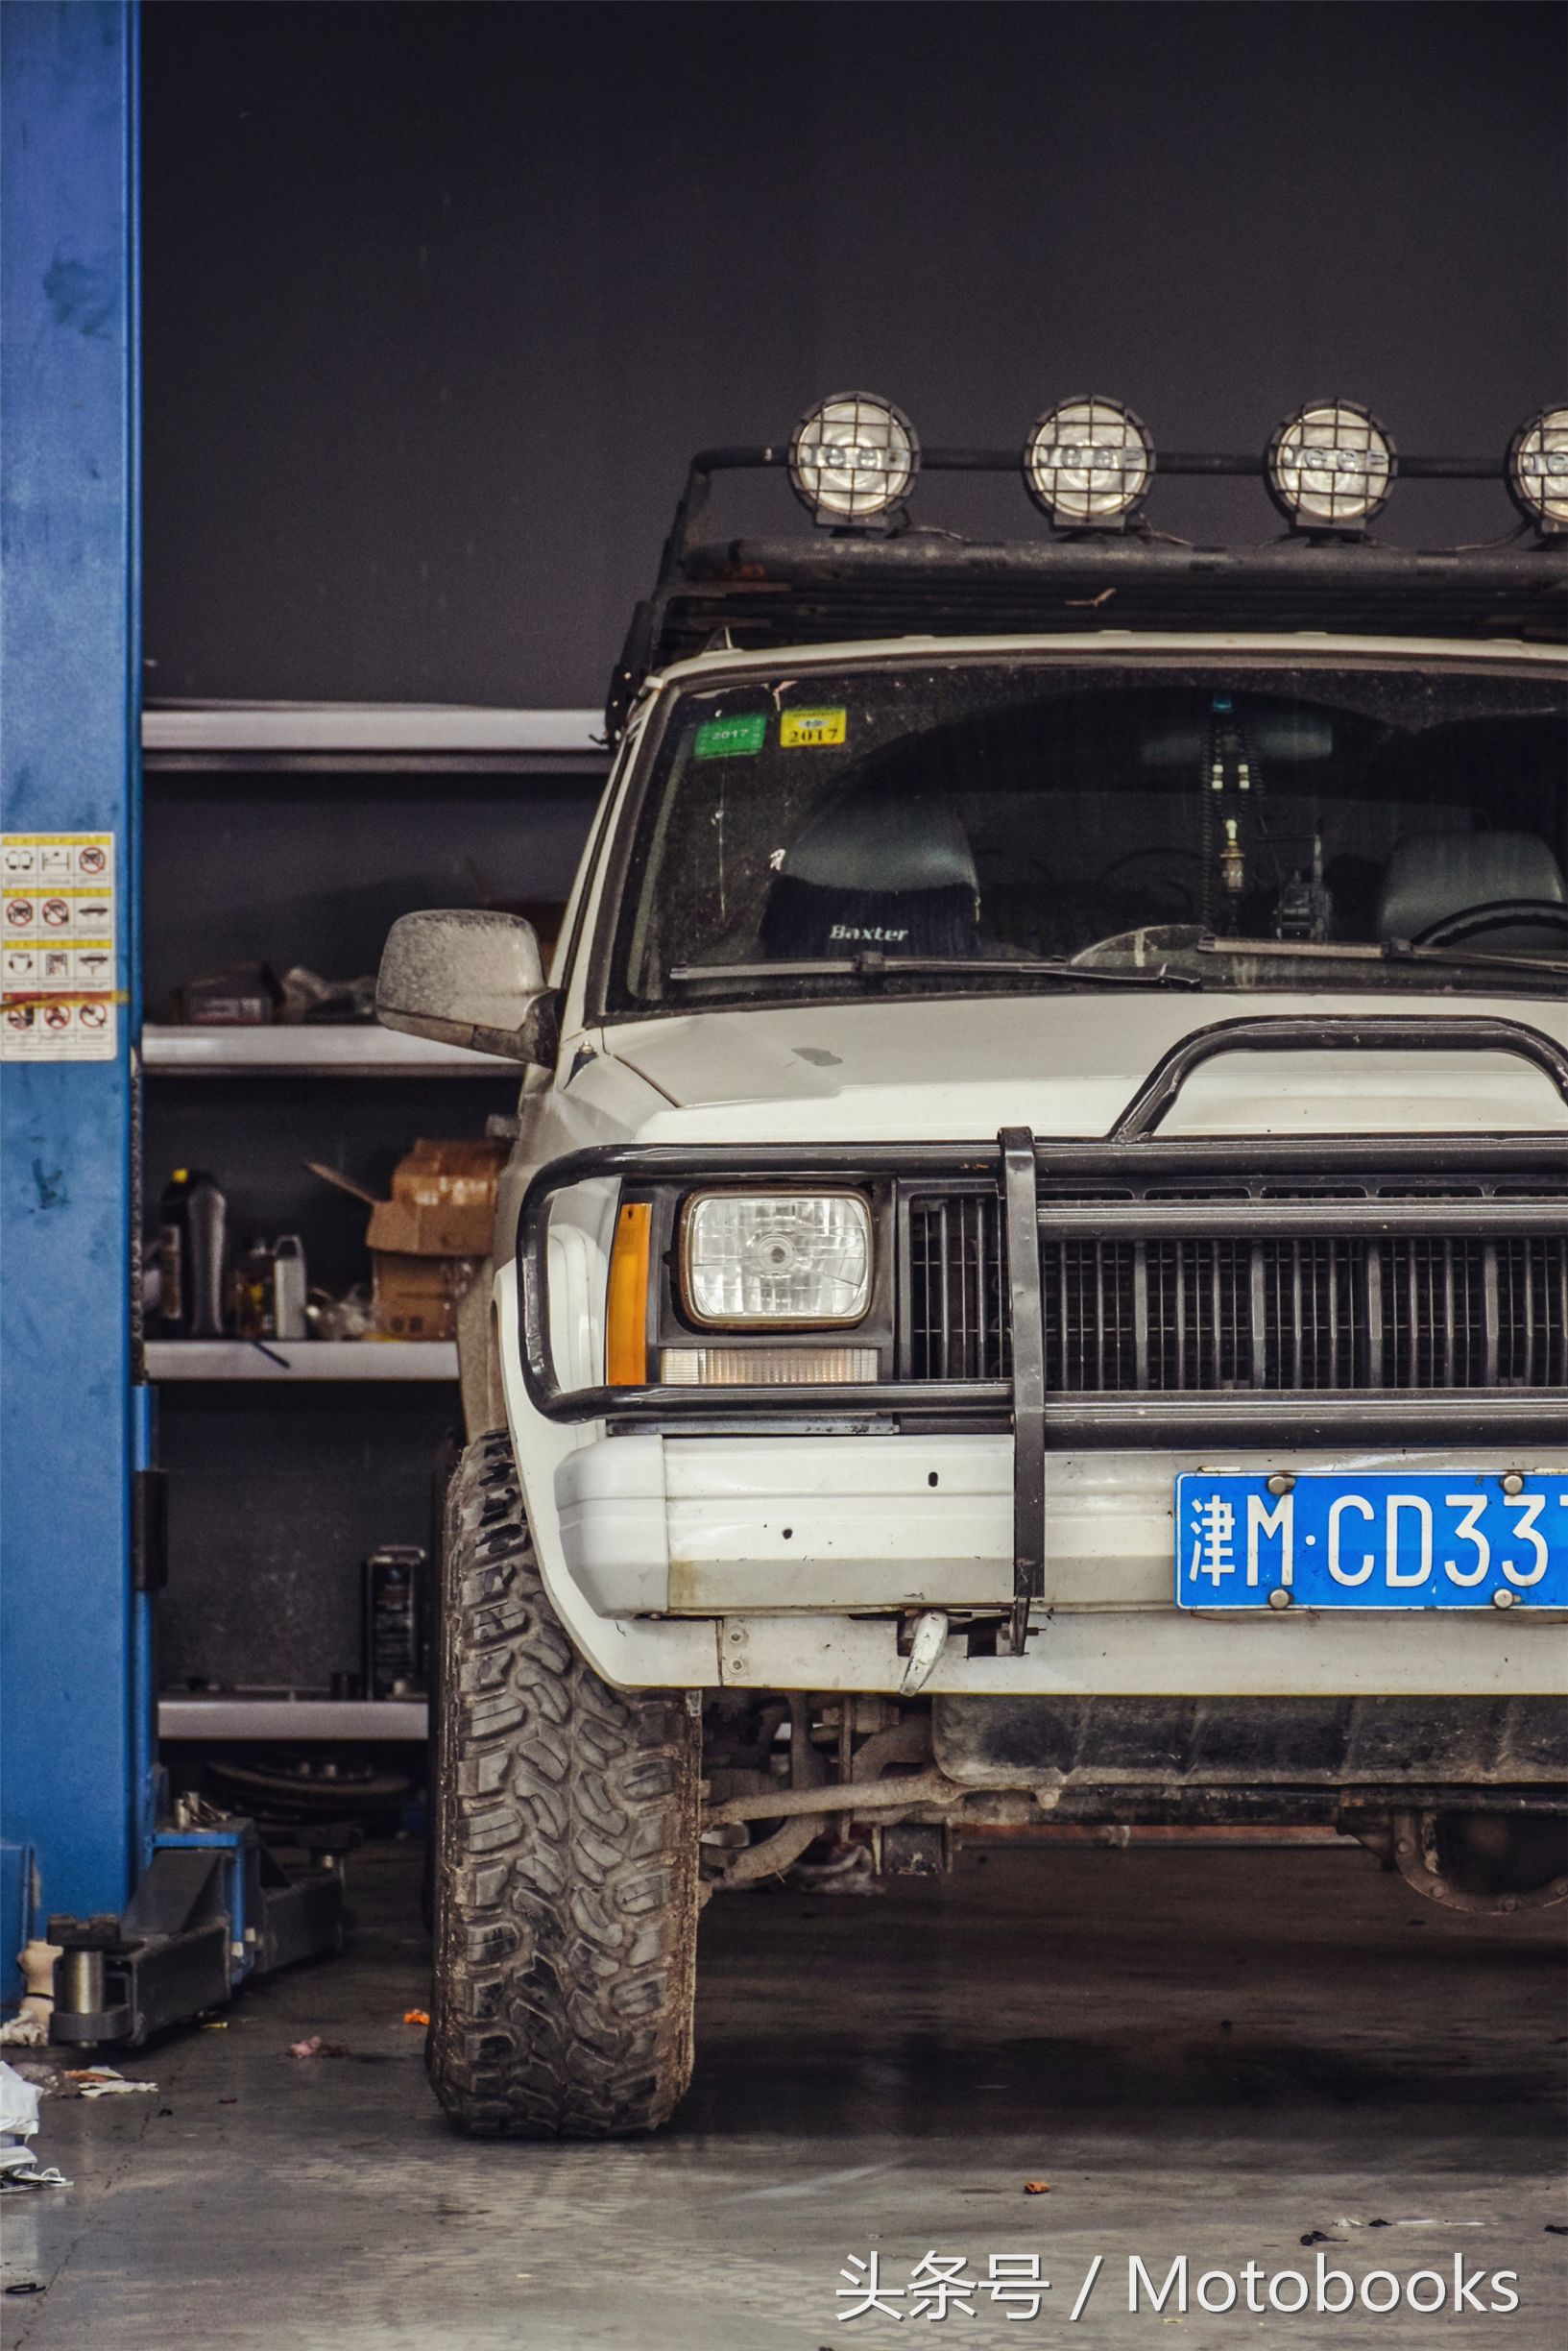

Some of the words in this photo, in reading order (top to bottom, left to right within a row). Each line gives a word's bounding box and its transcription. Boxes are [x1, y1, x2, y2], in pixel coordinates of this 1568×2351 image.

[712, 728, 749, 740] 2017
[788, 728, 838, 743] 2017
[830, 925, 908, 941] Baxter
[1189, 1494, 1568, 1588] 津M·CD33
